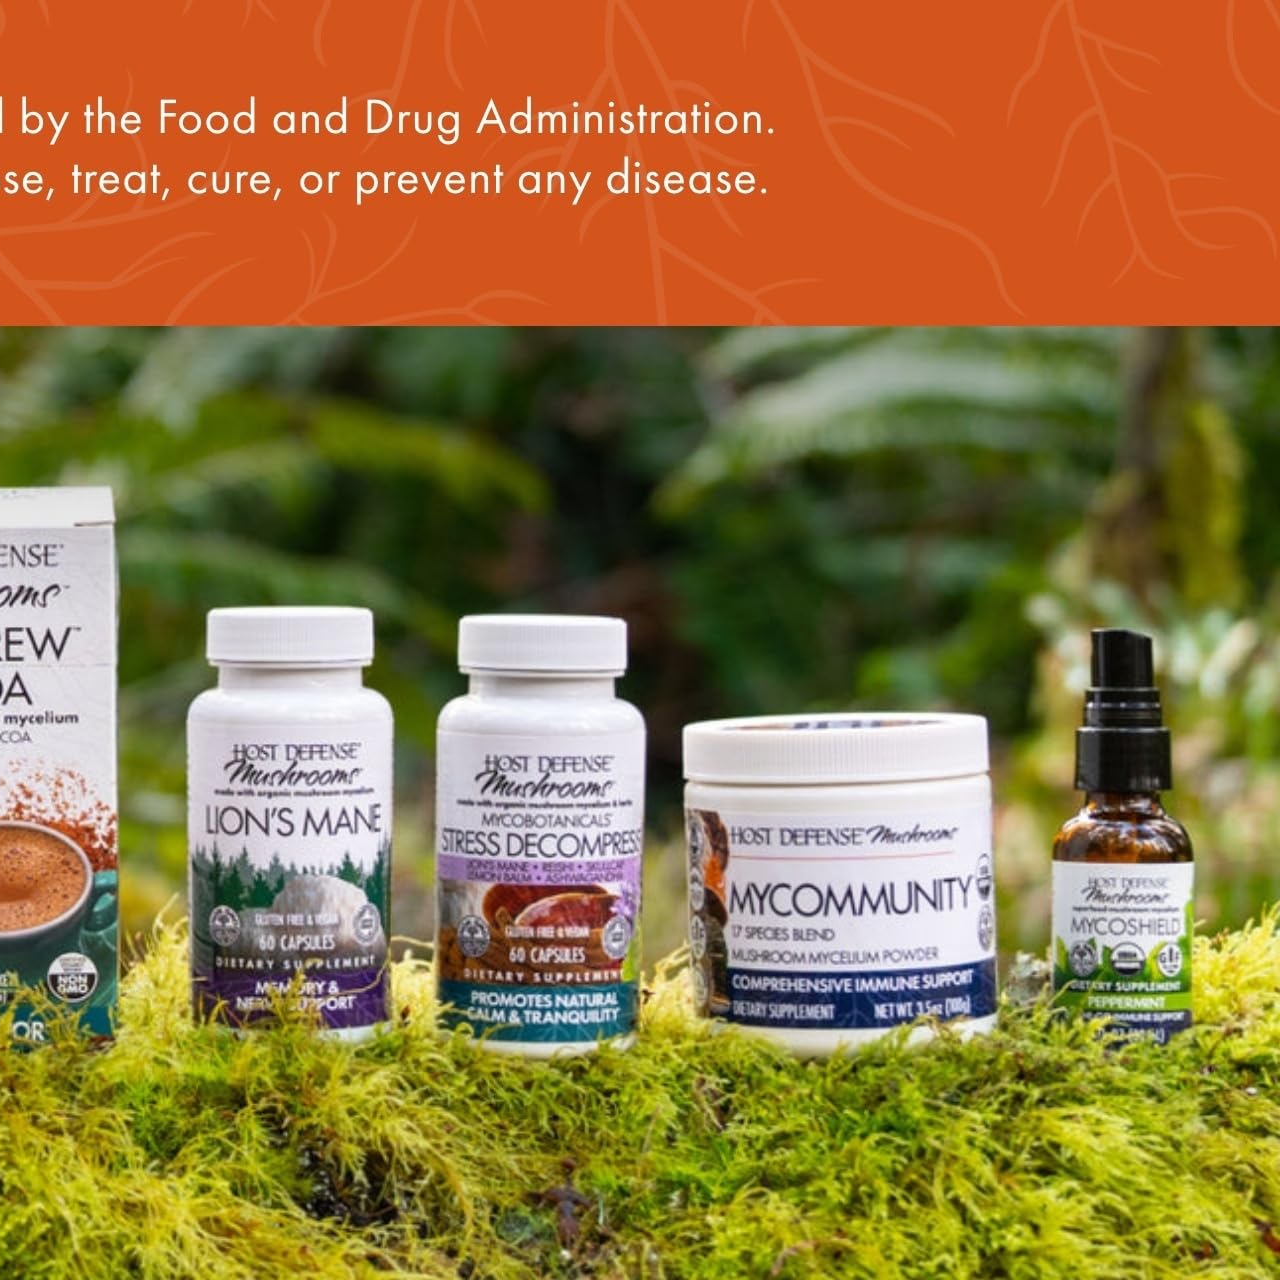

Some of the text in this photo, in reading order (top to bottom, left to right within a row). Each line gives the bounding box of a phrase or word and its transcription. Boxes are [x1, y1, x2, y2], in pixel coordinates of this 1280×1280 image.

[3, 710, 80, 728] mycelium
[232, 743, 278, 761] HOST
[484, 755, 531, 772] HOST
[224, 760, 360, 787] Mushrooms
[475, 770, 613, 798] Mushrooms
[206, 803, 381, 837] LION'S MANE
[442, 827, 500, 856] STRESS
[729, 827, 773, 846] HOST
[779, 827, 863, 847] DEFENSE
[729, 875, 974, 917] MYCOMMUNITY
[745, 926, 790, 941] SPECIES
[792, 928, 836, 942] BLEND
[1071, 917, 1181, 936] MYCOSHIELD
[259, 934, 336, 951] 60 CAPSULES
[216, 955, 376, 970] DIETARY SUPPLEMENT
[509, 946, 586, 963] 60 CAPSULES
[731, 946, 939, 966] MUSHROOM MYCELIUM POWDER
[57, 974, 88, 984] NON
[731, 968, 975, 994] COMPREHENSIVE IMMUNE SUPPORT
[57, 983, 89, 994] GMO
[471, 990, 619, 1008] PROMOTES NATURAL
[508, 1008, 520, 1024] &
[523, 1006, 621, 1025] TRANQUILITY
[769, 1003, 836, 1020] SUPPLEMENT
